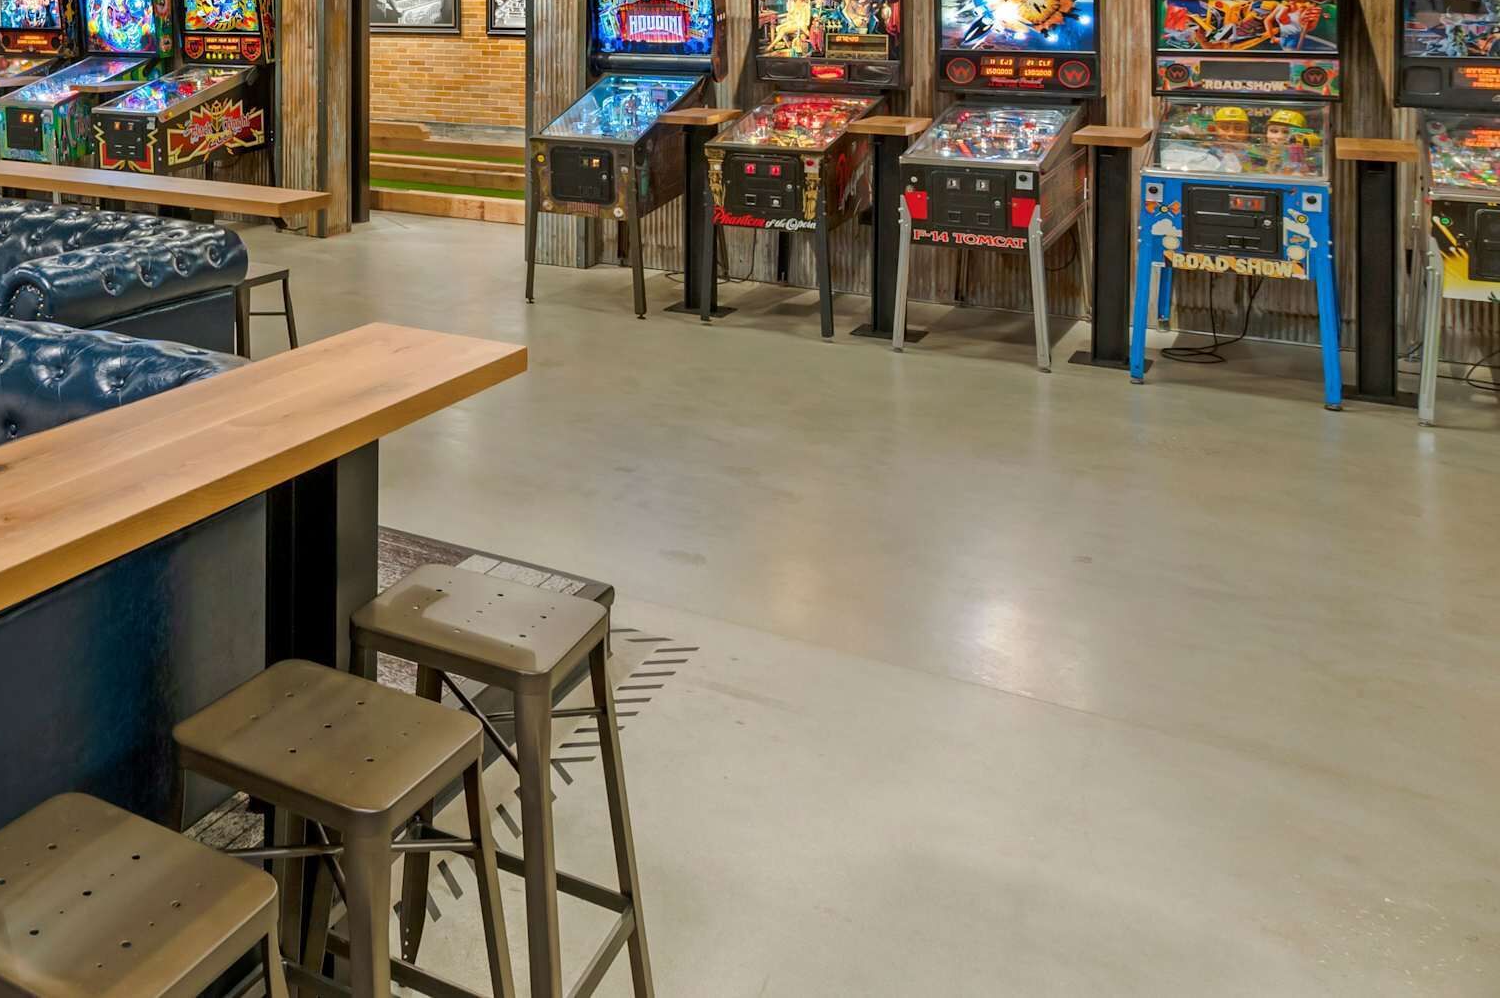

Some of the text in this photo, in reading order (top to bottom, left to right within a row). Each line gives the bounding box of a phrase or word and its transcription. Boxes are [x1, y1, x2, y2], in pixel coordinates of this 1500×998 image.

[629, 14, 684, 38] HOUDINI
[1204, 80, 1285, 92] ROAD SHOW
[712, 204, 766, 228] Phantom
[913, 228, 1027, 250] F-14 TOMCAT
[1171, 253, 1294, 279] ROAD SHOW
